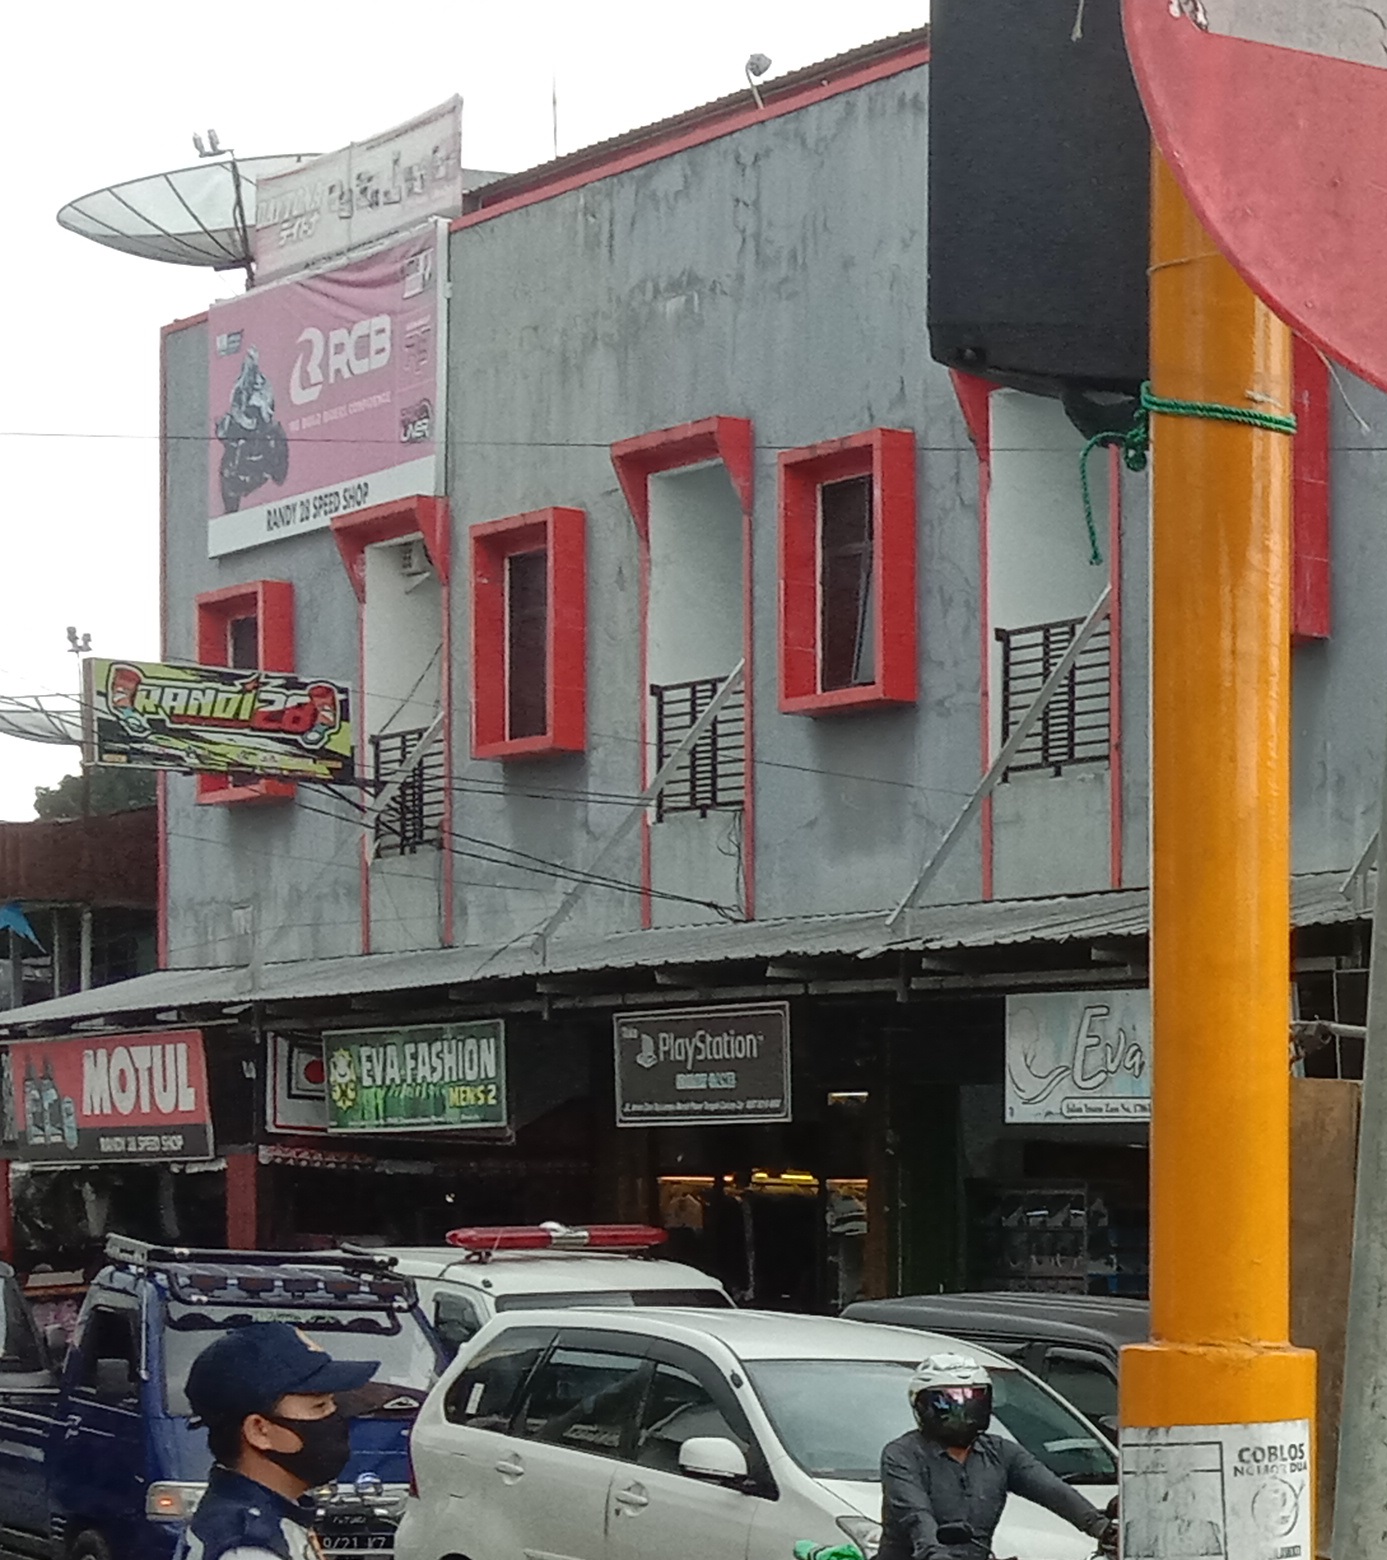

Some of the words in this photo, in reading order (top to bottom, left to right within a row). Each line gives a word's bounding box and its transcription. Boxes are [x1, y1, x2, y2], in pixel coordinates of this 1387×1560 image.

[329, 314, 391, 384] RCB
[360, 1044, 401, 1087] EVA
[403, 1037, 497, 1084] FASHION
[659, 1029, 758, 1070] PlayStation
[83, 1042, 195, 1115] MOTUL
[1238, 1443, 1306, 1464] COBLOS
